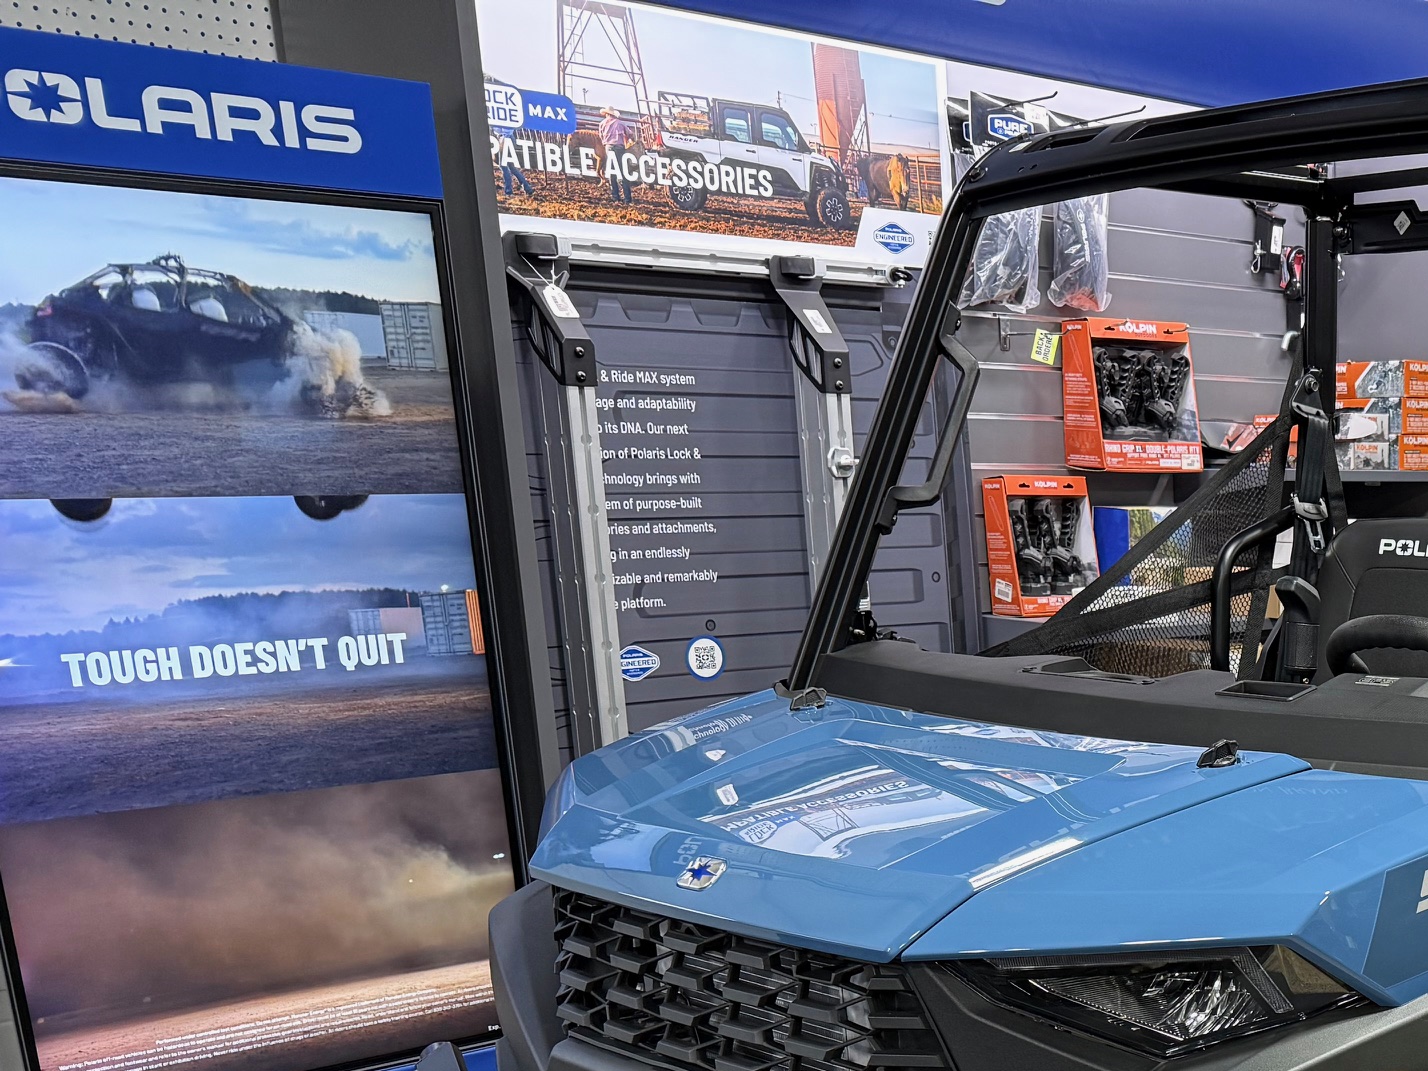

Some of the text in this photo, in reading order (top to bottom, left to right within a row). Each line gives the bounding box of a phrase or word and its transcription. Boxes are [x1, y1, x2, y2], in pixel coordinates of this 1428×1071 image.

[4, 68, 363, 154] OLARIS
[487, 104, 568, 123] IDE MAX
[995, 118, 1028, 134] PURE
[490, 136, 774, 198] PATIBLE ACCESSORIES
[875, 232, 913, 243] ENGINEERED
[1120, 322, 1157, 333] KOLPIN
[1042, 333, 1053, 362] ORDERE
[600, 370, 695, 386] & Ride MAX system
[596, 397, 696, 412] age and adaptability
[604, 422, 618, 434] its
[620, 422, 645, 434] DNA.
[647, 422, 664, 434] Our
[666, 423, 689, 434] next
[1404, 437, 1428, 445] KOLPIN
[600, 447, 701, 459] ion of Polaris Lock &
[602, 473, 700, 487] hnology brings with
[605, 497, 702, 512] em of purpose-built
[632, 522, 650, 534] and
[652, 522, 717, 534] attachments,
[619, 548, 628, 559] in
[631, 549, 643, 559] an
[646, 546, 690, 560] endlessly
[612, 569, 718, 585] izable and remarkably
[621, 598, 666, 611] platform.
[60, 632, 406, 687] TOUGH DOESN'T QUIT
[620, 658, 657, 667] GINEERED
[58, 1062, 83, 1071] Warning:
[83, 1058, 102, 1066] Polaris
[124, 1050, 145, 1058] vehicles
[124, 1058, 147, 1066] footwear
